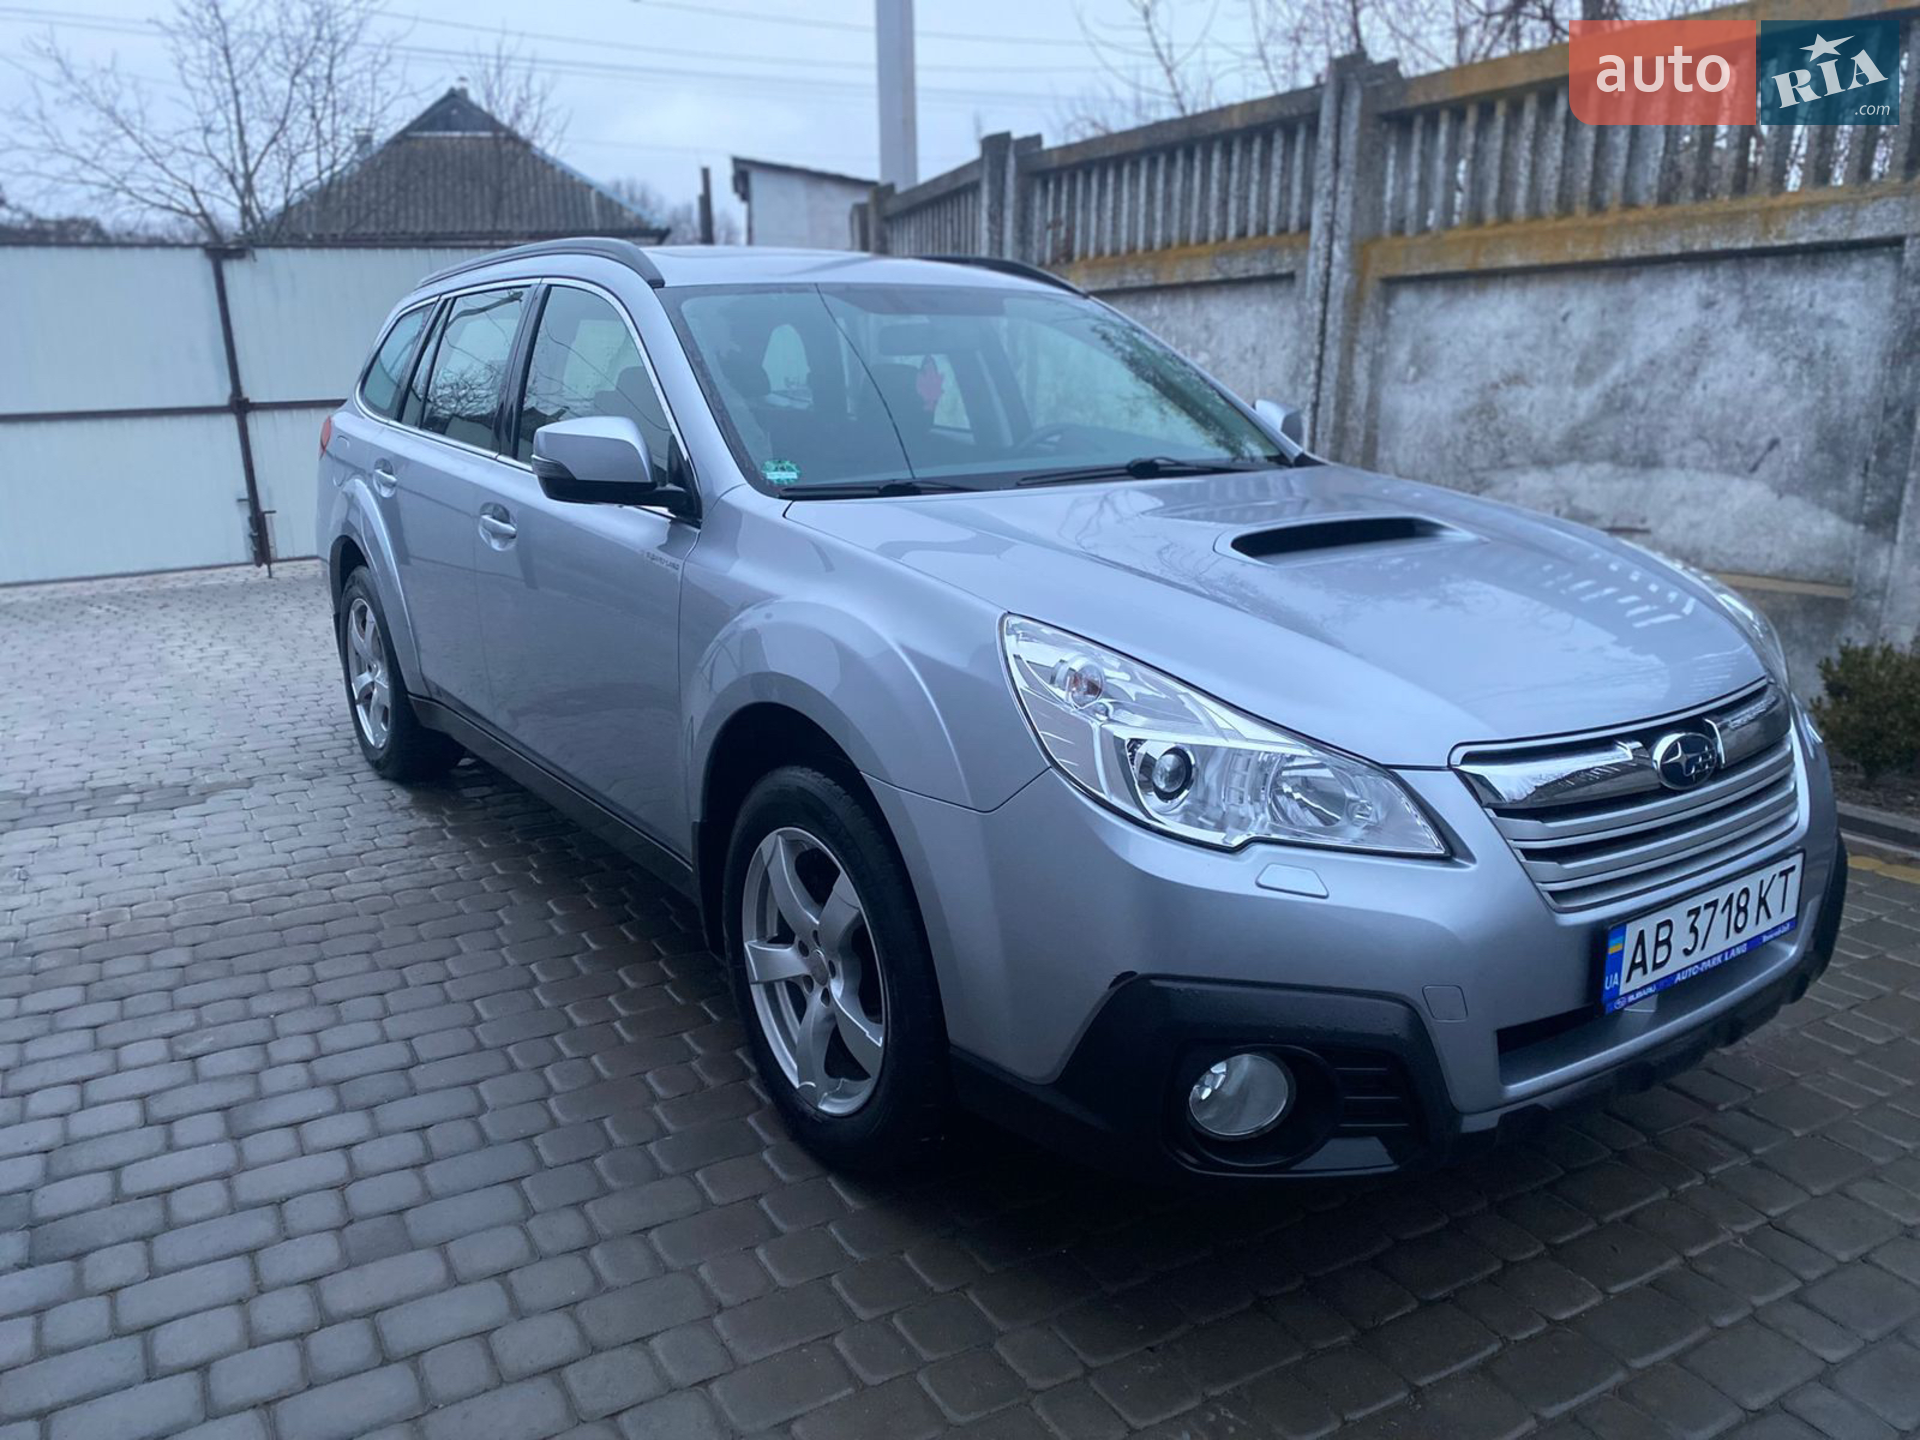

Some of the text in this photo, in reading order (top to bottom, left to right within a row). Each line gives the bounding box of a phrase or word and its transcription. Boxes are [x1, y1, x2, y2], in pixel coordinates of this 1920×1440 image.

[1625, 865, 1796, 984] AB 3718 KT
[1605, 972, 1619, 990] UA
